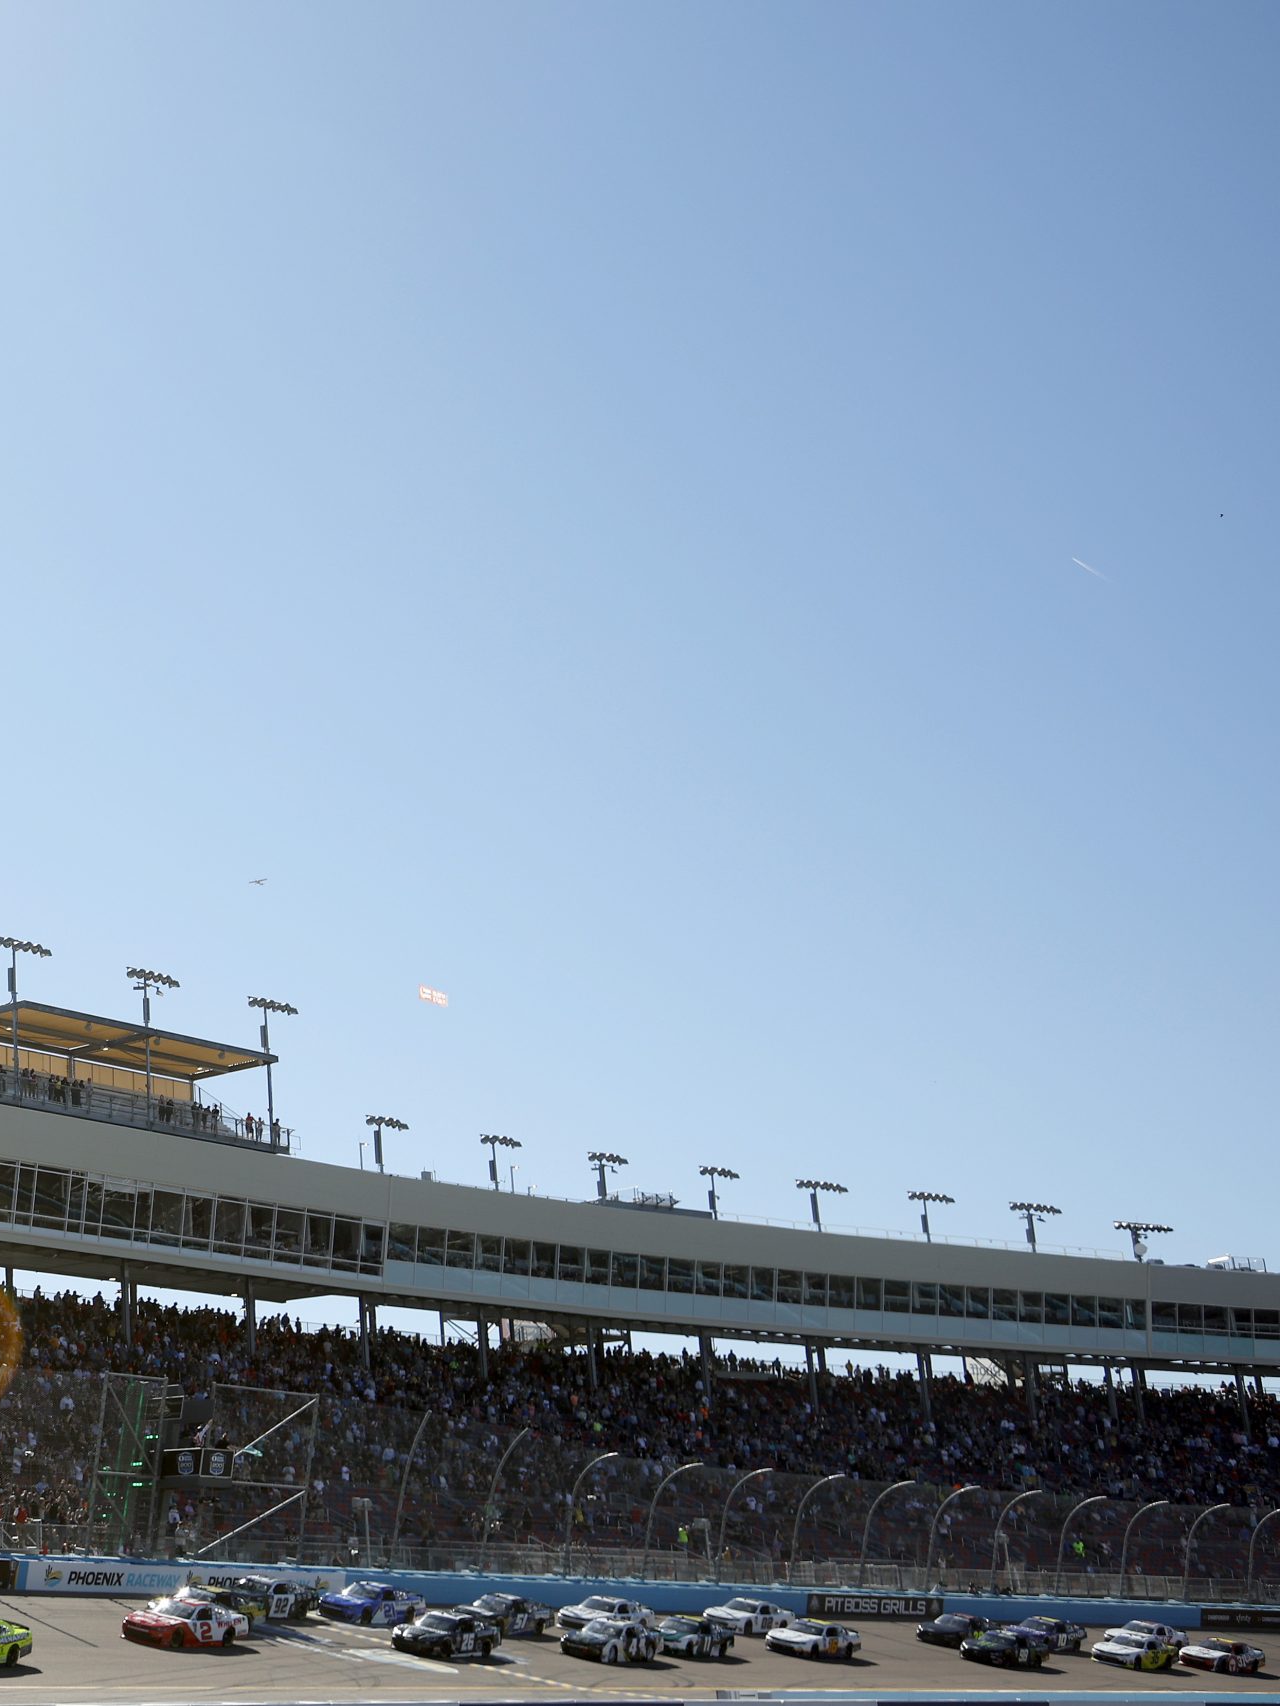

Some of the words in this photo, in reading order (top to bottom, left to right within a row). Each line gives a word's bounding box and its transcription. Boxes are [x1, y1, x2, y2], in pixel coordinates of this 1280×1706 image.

[67, 1570, 125, 1587] PHOENIX
[126, 1572, 181, 1588] RACEWAY
[273, 1596, 290, 1614] 92
[382, 1601, 396, 1619] 21
[825, 1597, 842, 1612] PIT
[844, 1598, 879, 1613] BOSS
[881, 1599, 926, 1615] GRILLS
[513, 1613, 529, 1630] 51
[200, 1622, 213, 1640] 2
[1057, 1633, 1068, 1647] 10
[461, 1633, 476, 1652] 26
